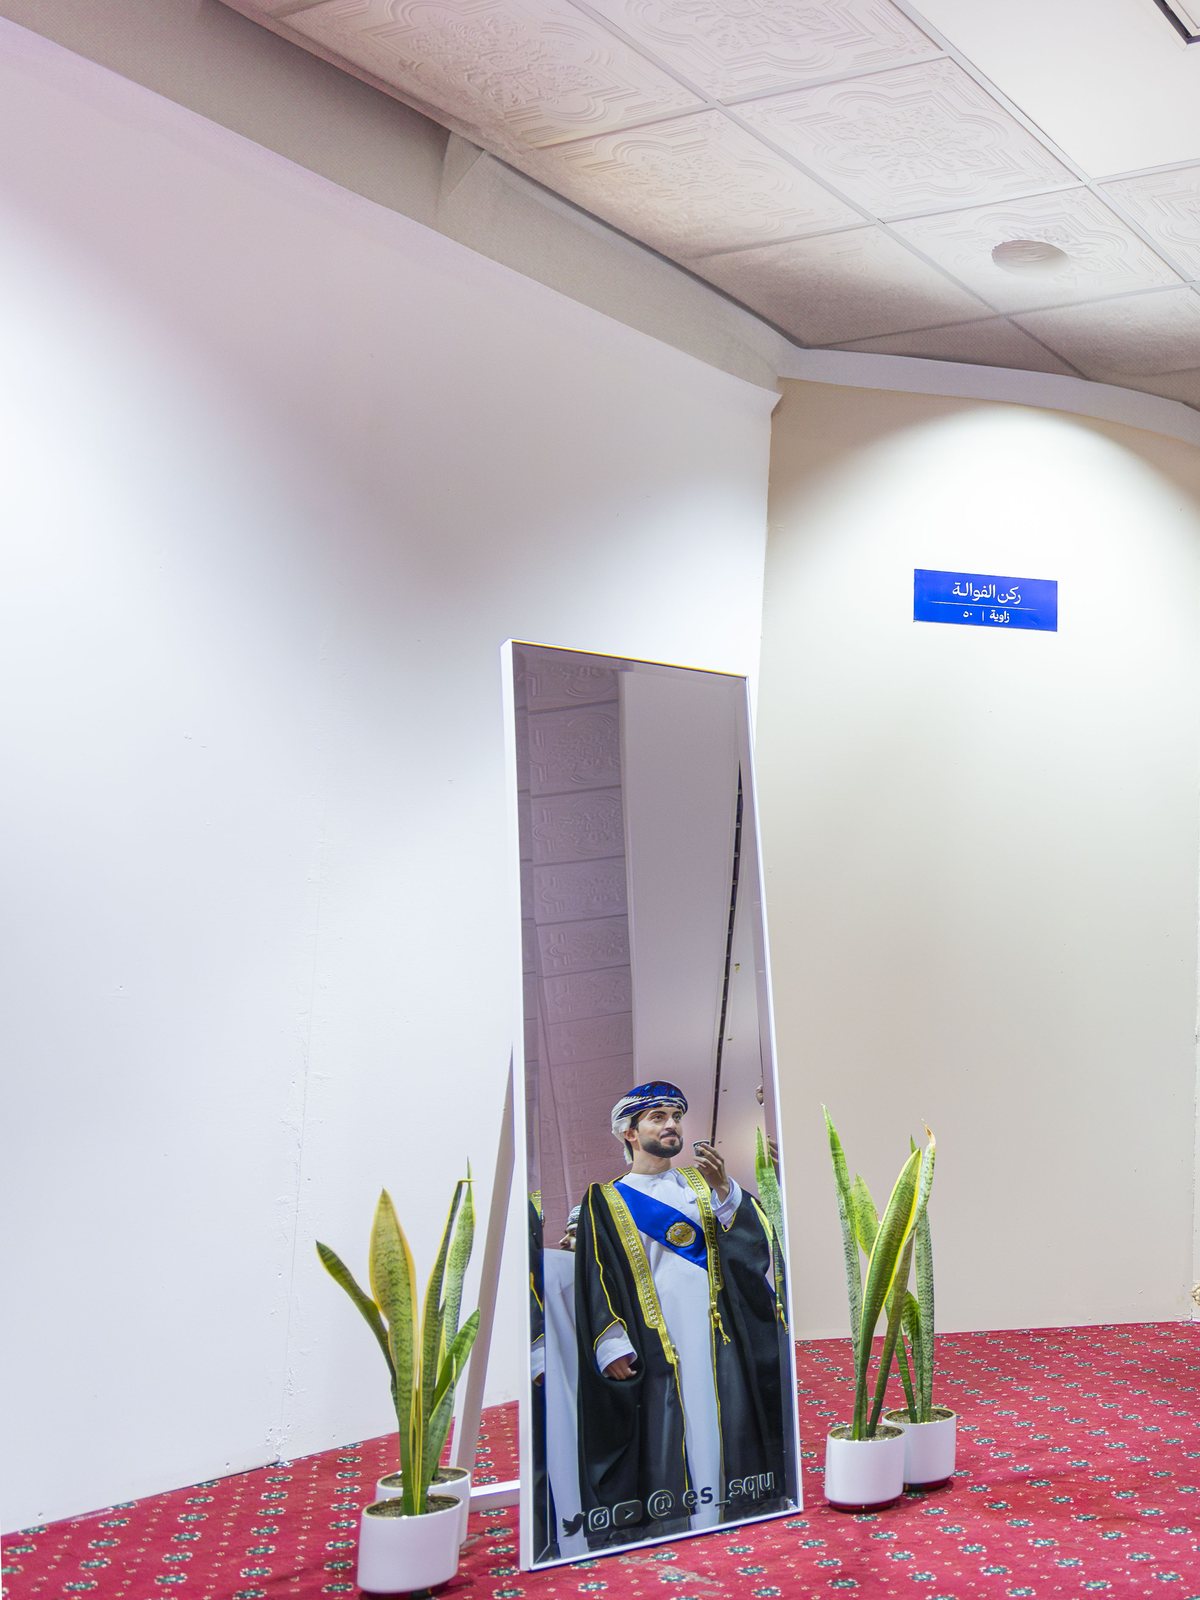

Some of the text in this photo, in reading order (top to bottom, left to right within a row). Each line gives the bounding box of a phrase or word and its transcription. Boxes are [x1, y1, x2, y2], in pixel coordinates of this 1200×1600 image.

[952, 582, 1022, 604] ركن الفوالة
[989, 609, 1010, 623] زاوية
